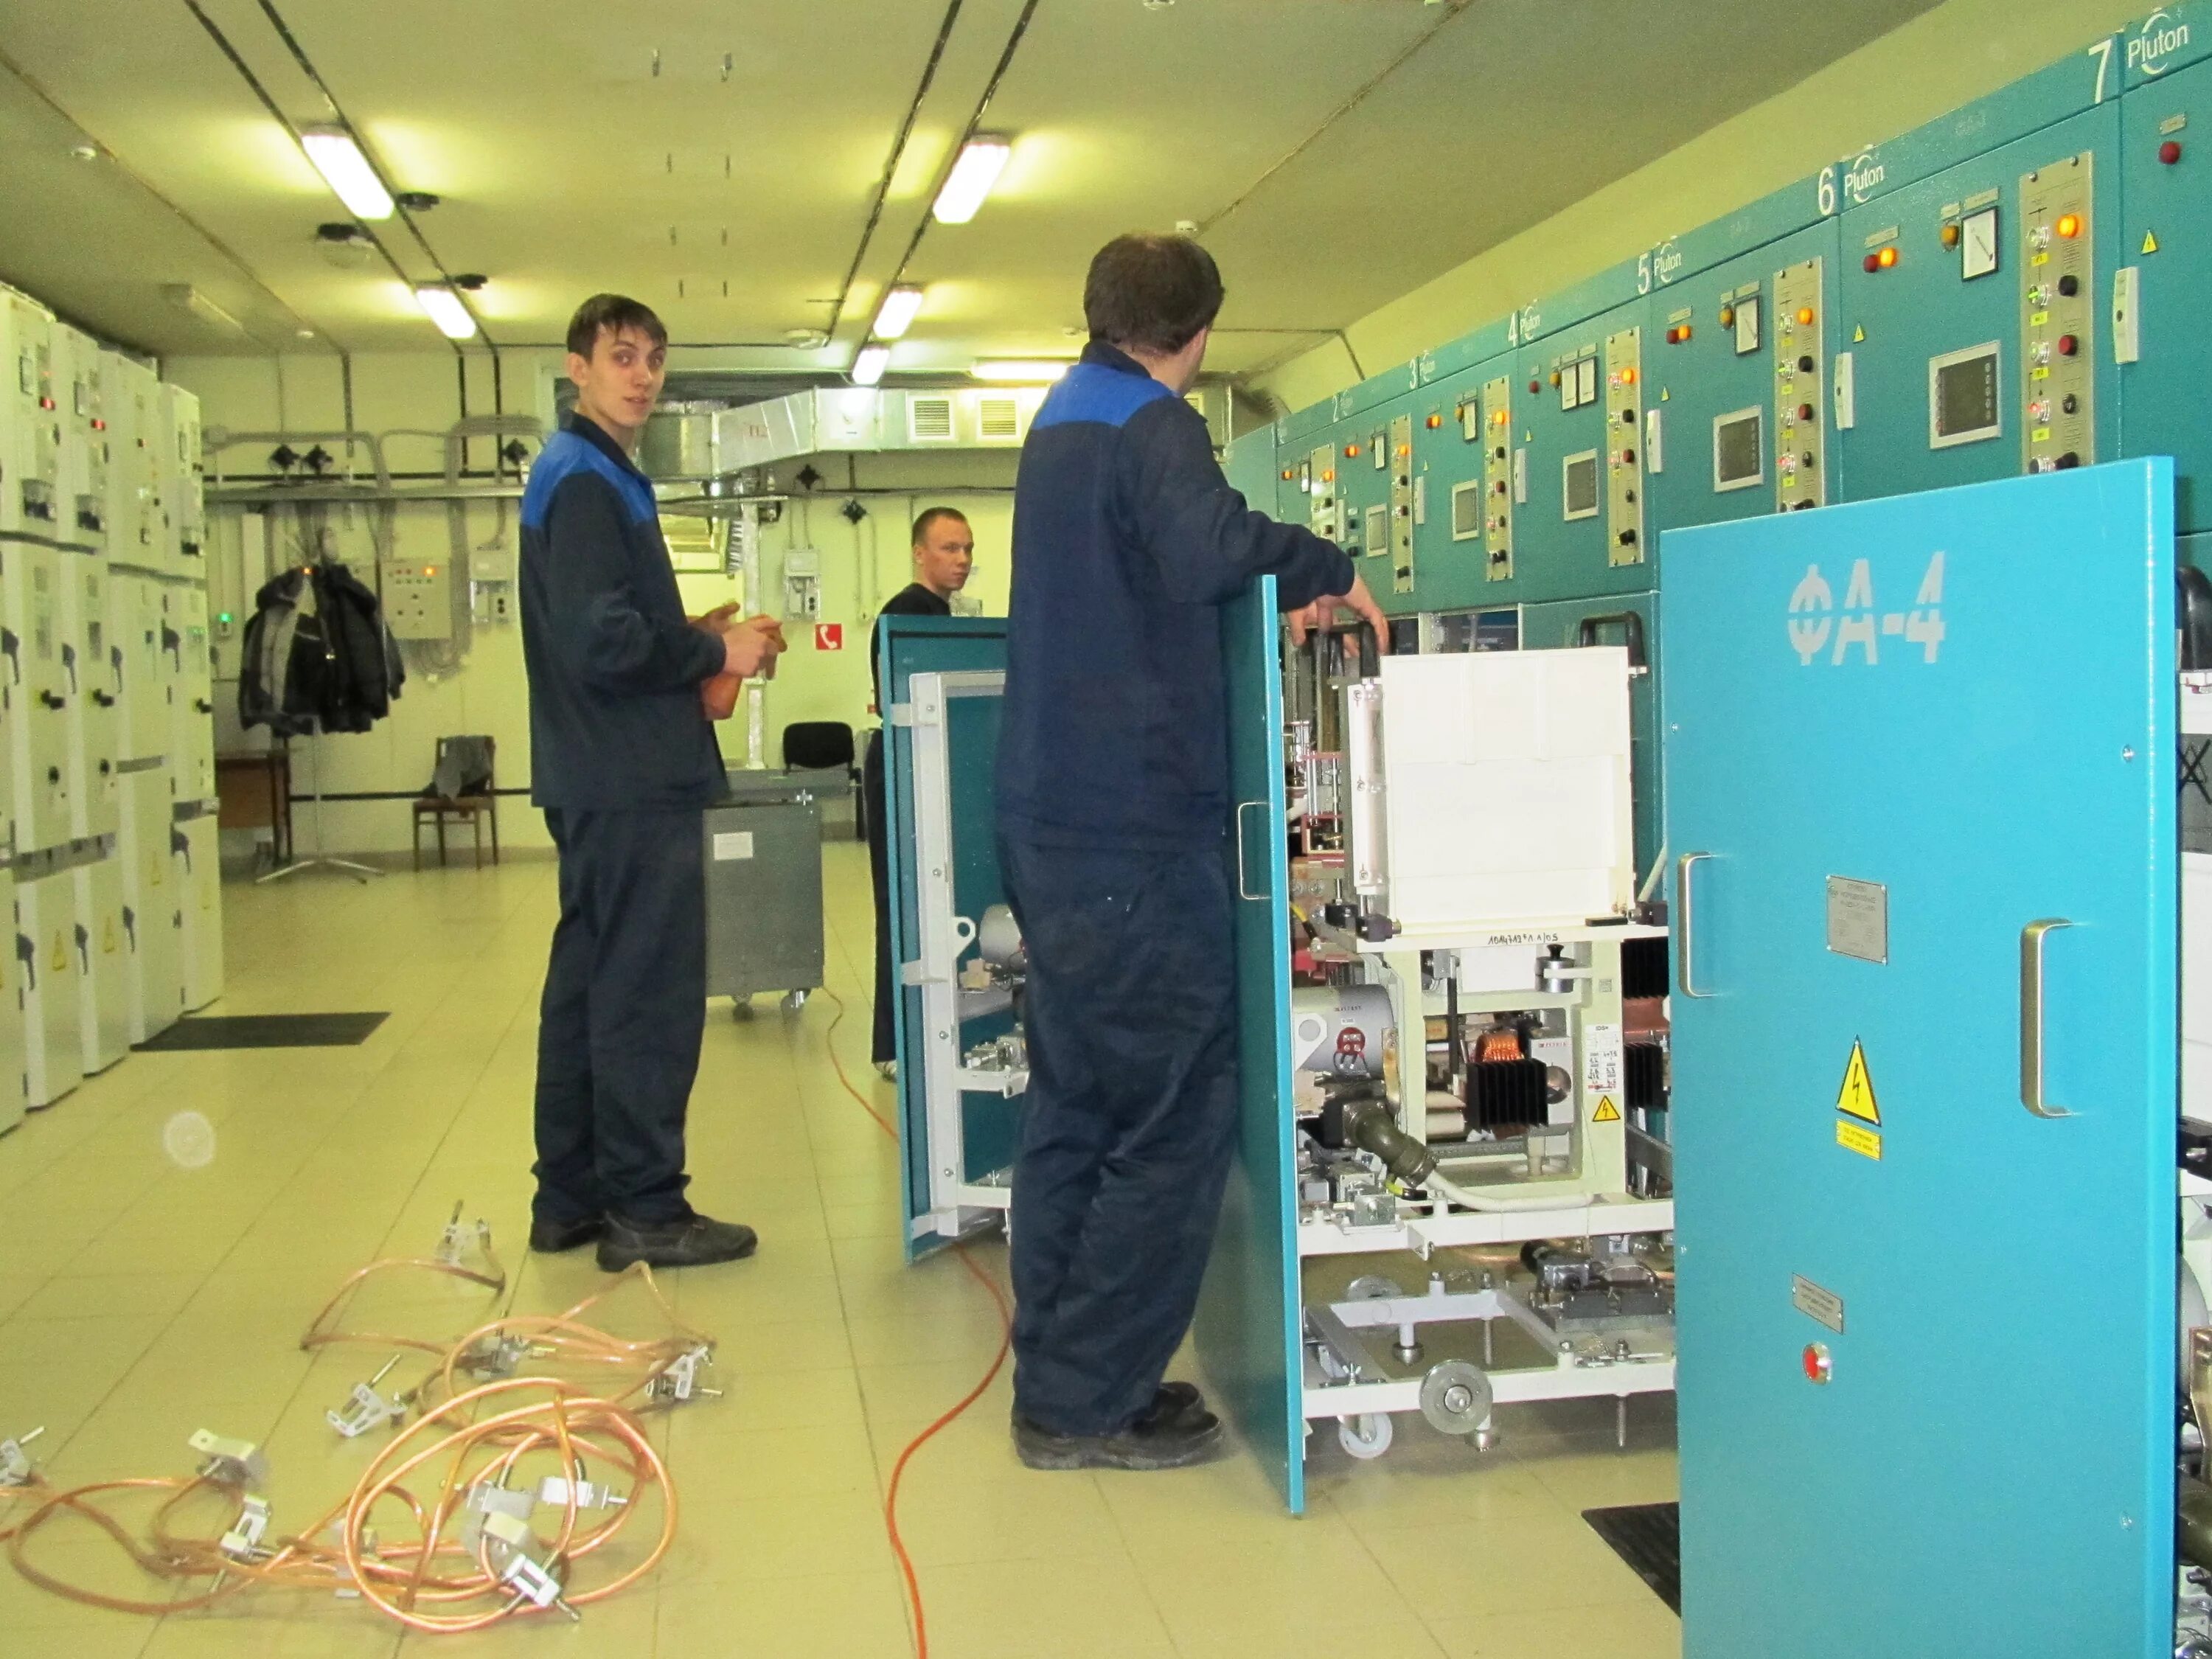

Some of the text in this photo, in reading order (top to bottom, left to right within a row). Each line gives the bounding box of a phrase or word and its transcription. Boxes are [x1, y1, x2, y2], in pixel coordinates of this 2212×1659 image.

[2128, 24, 2189, 68] Pluton
[2088, 38, 2112, 104] 7
[1818, 167, 1834, 215] 6
[1844, 165, 1884, 196] Pluton
[1637, 252, 1649, 295] 5
[1654, 252, 1681, 276] Pluton
[1507, 312, 1517, 347] 4
[1409, 358, 1417, 389] 3
[1787, 551, 1945, 666] ФА-4
